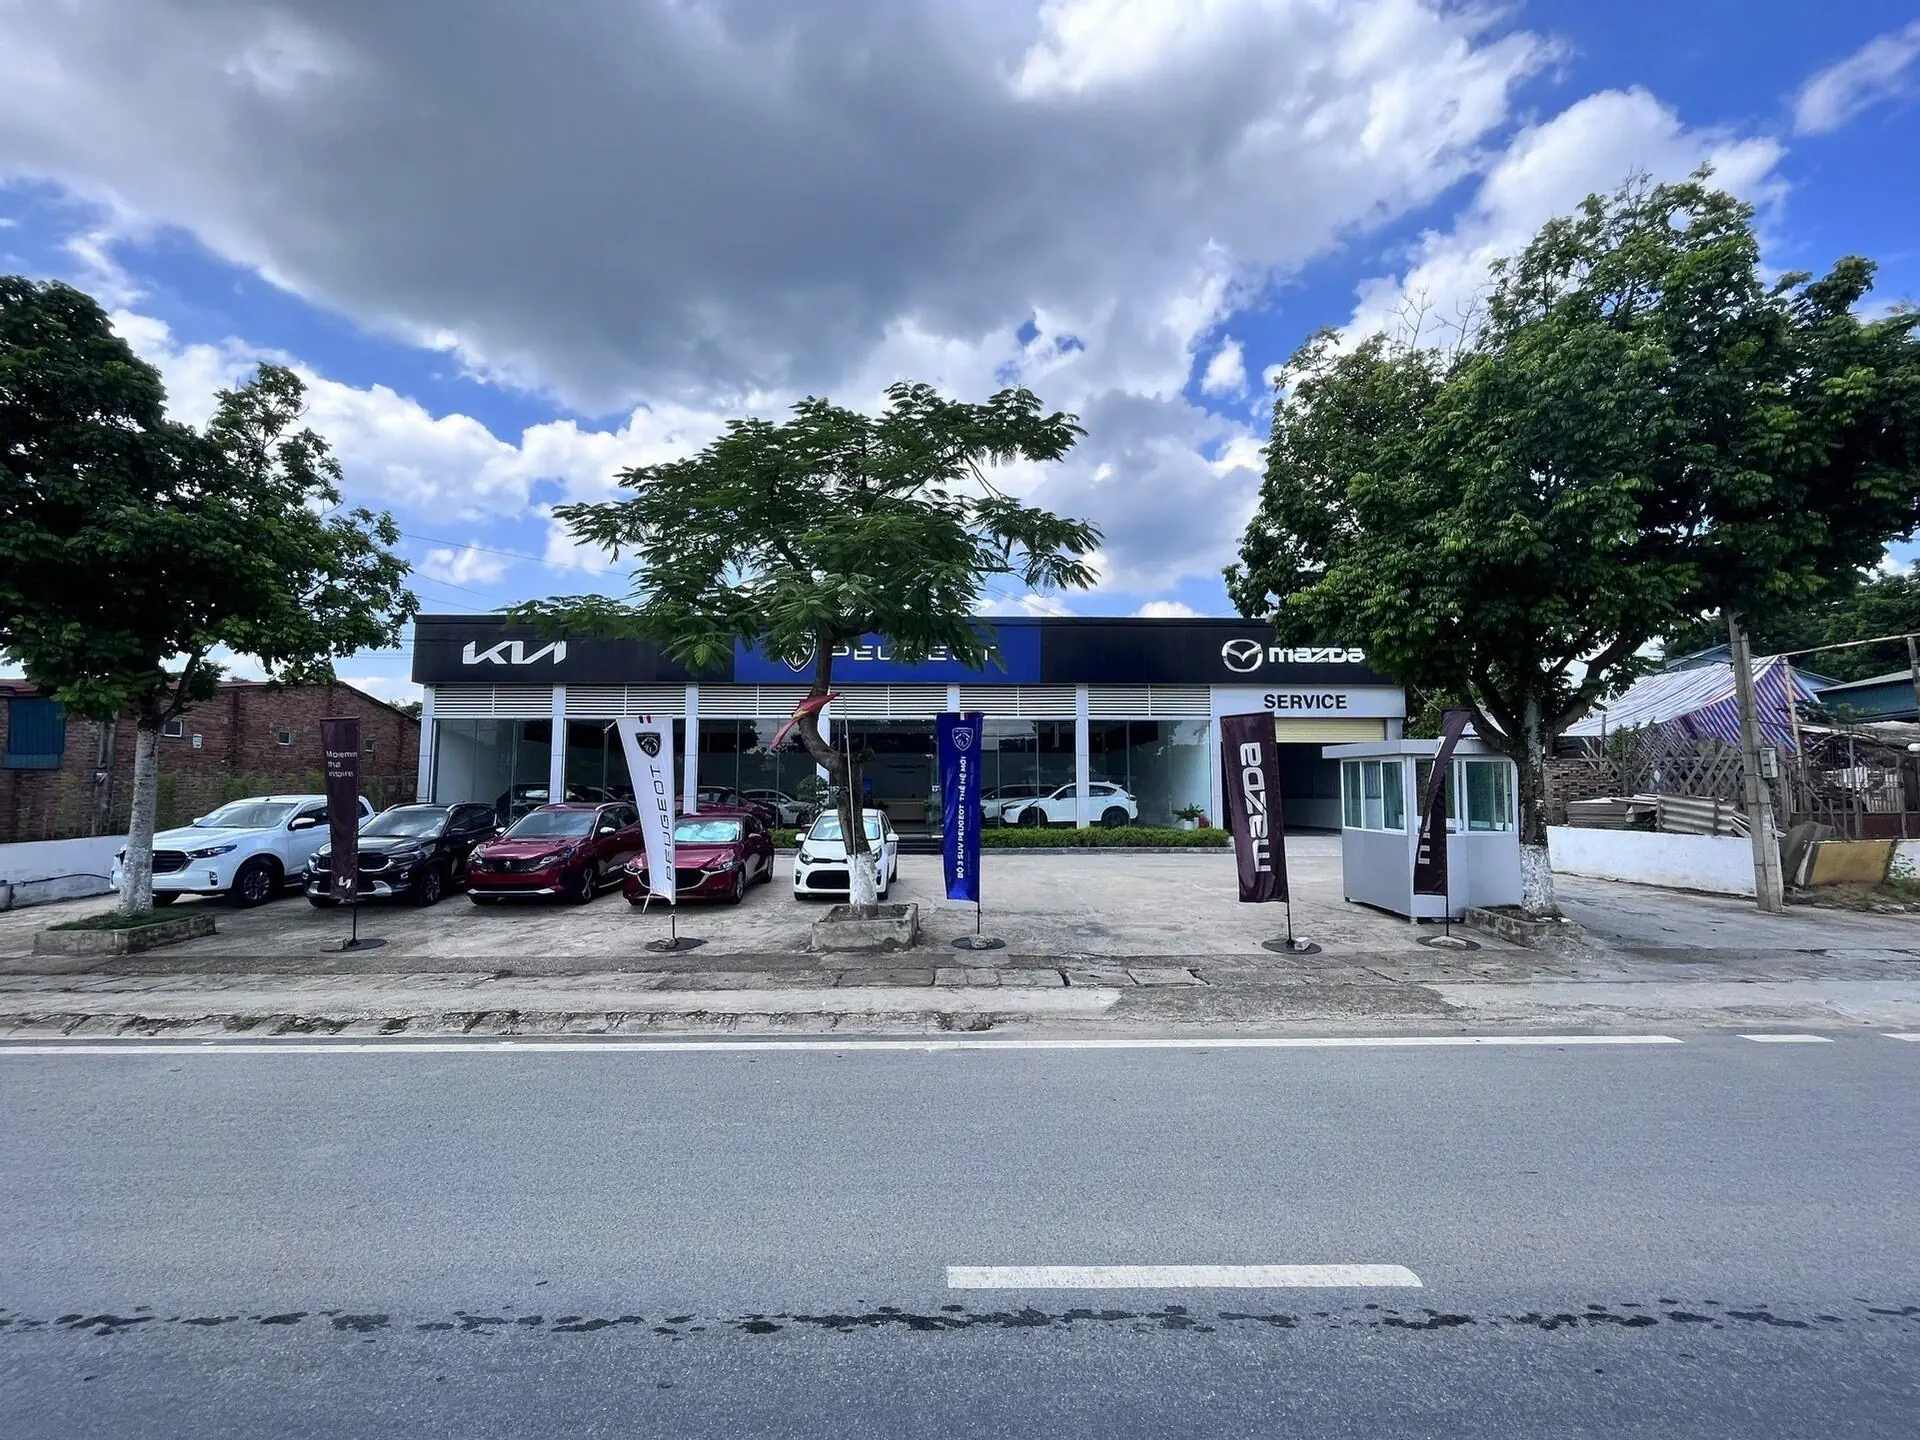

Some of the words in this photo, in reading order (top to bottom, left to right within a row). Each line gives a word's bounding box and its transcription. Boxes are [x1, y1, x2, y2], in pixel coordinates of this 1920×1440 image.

[462, 640, 567, 665] KIA
[831, 645, 997, 661] PEUET
[1264, 694, 1348, 710] SERVICE
[650, 764, 673, 882] PEUGEOT
[957, 804, 965, 842] PEUGEOT
